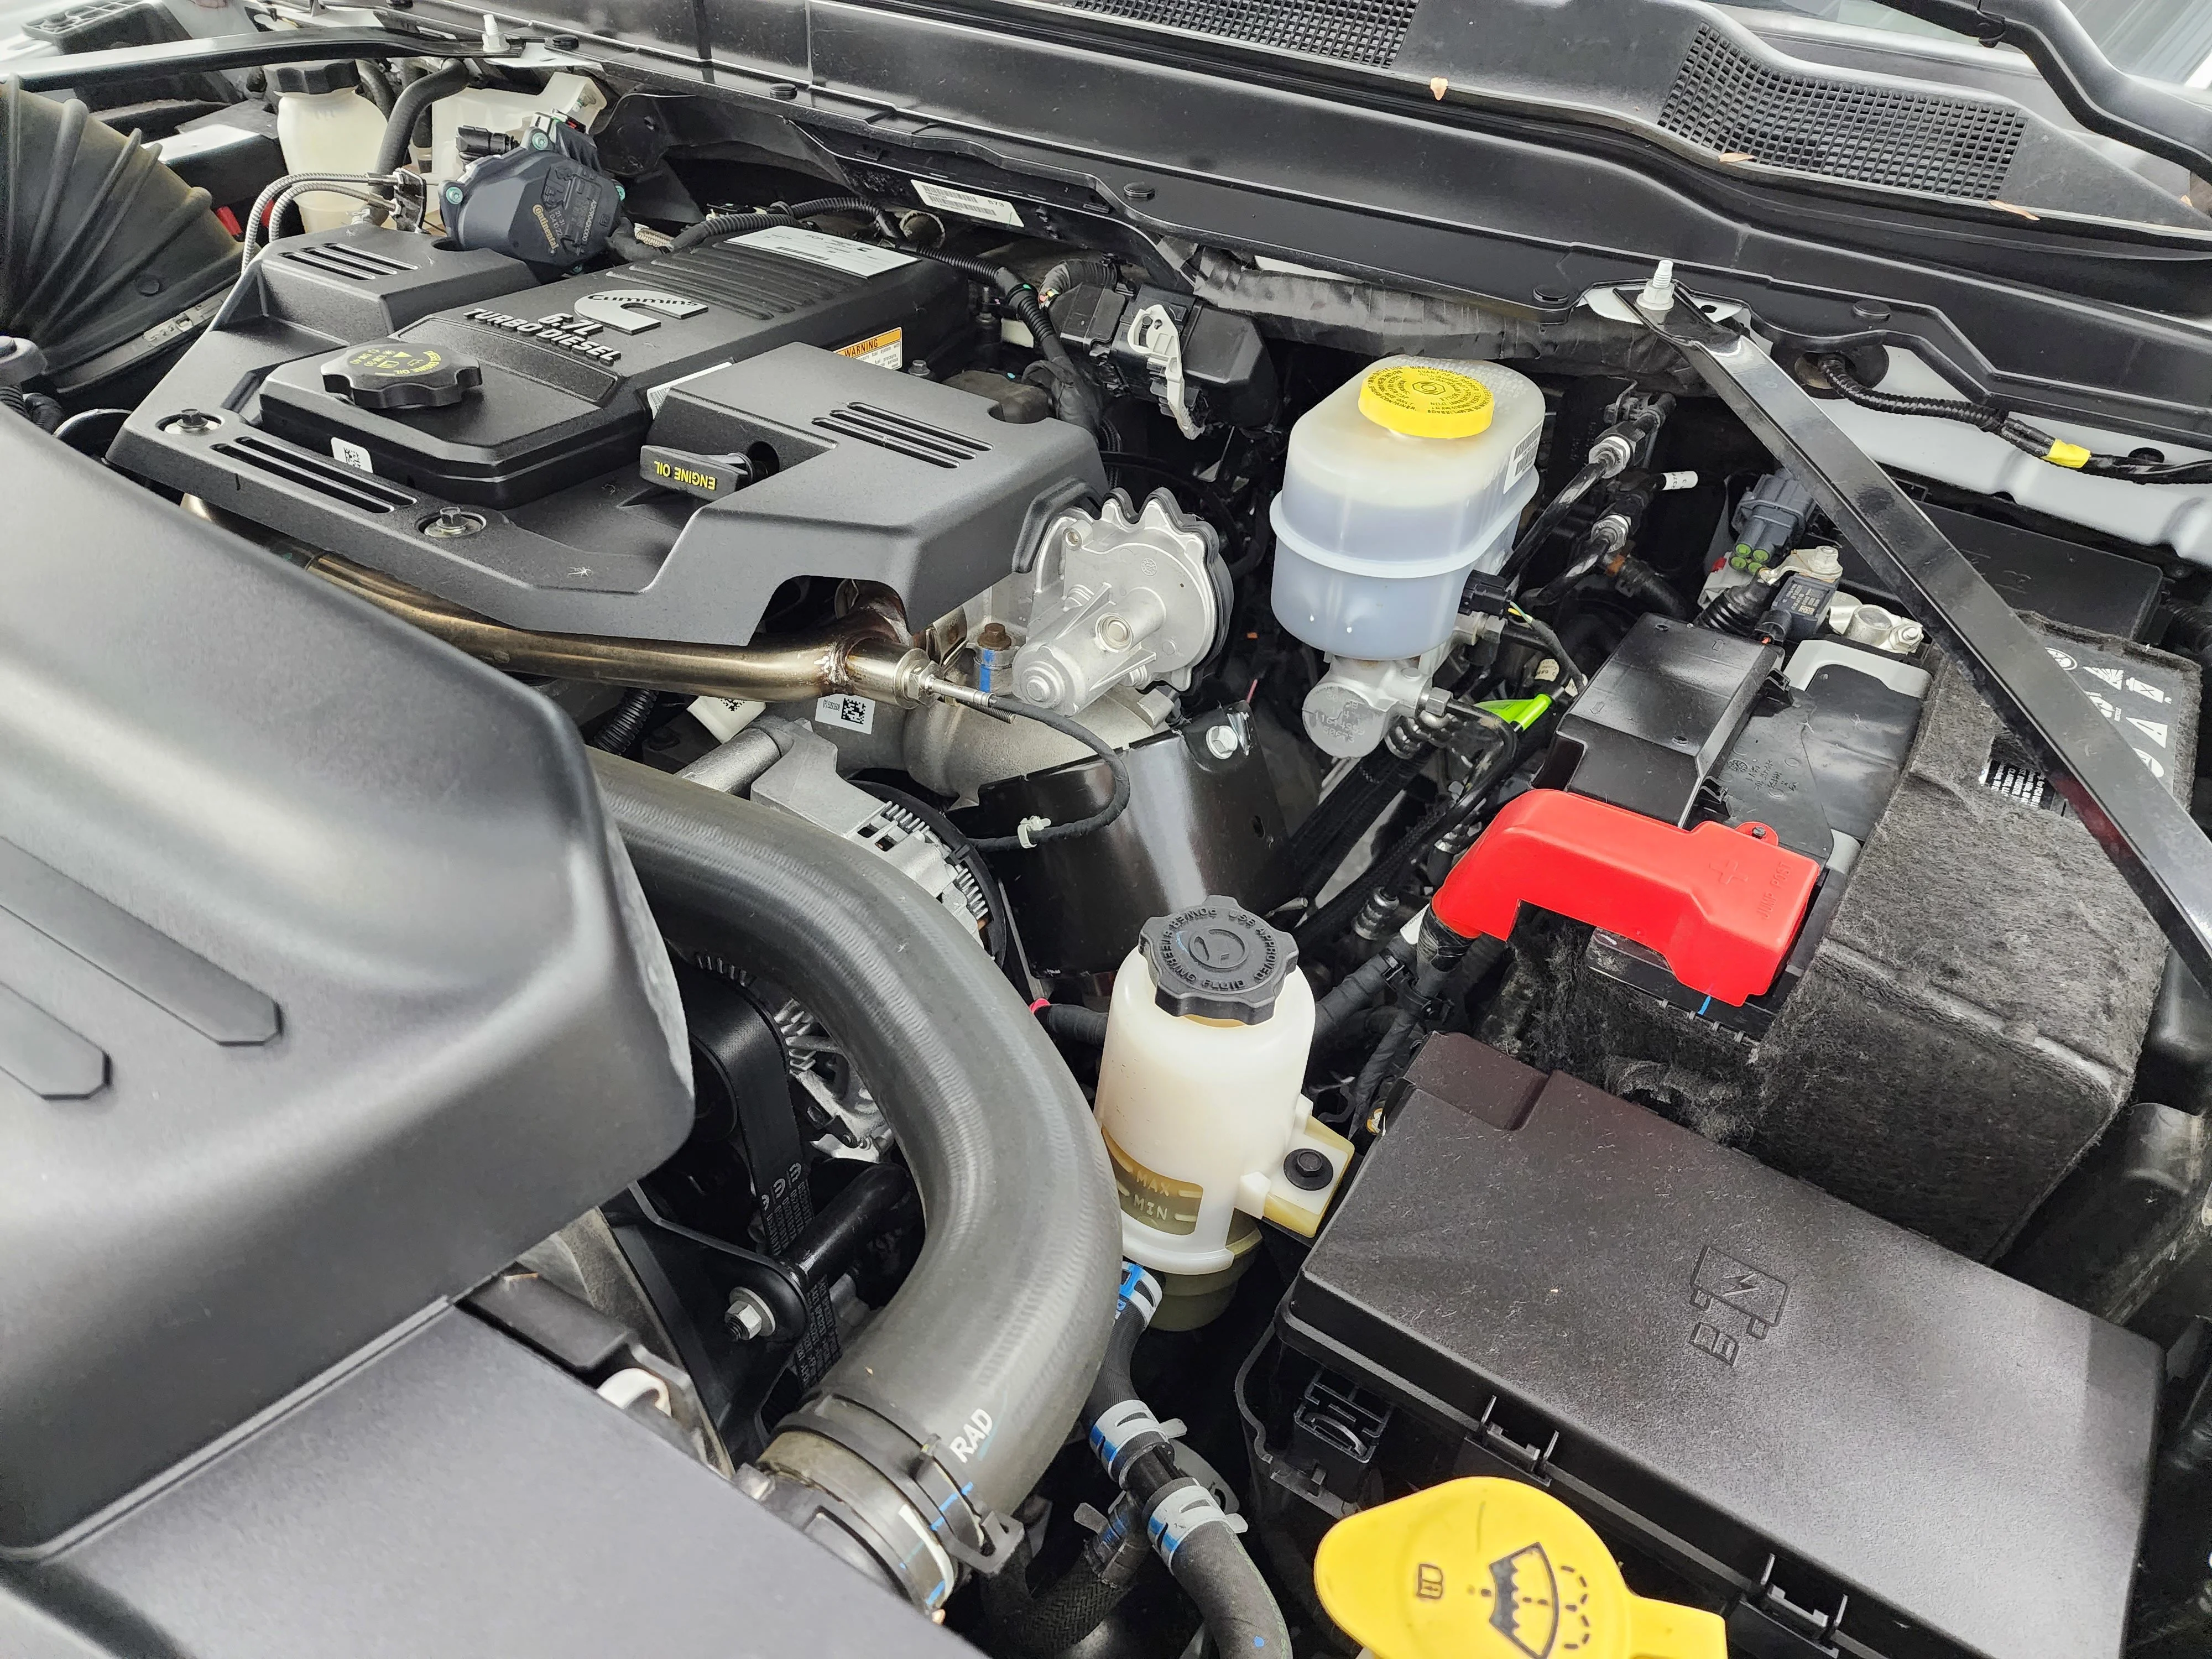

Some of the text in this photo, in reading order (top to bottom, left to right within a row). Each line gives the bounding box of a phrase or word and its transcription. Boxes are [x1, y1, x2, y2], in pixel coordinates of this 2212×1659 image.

[532, 204, 559, 249] Continental
[588, 295, 700, 306] Cummins
[463, 308, 621, 366] TURBO DIESEL
[538, 313, 604, 338] 6.7L
[844, 339, 878, 357] WARNING
[654, 460, 717, 491] ENGINE OIL
[1759, 861, 1792, 920] JUMP POST
[1161, 907, 1246, 991] POWER STEERING FLUID
[1228, 911, 1276, 981] USE APPROVED
[1136, 1173, 1170, 1196] MAX
[1133, 1194, 1168, 1220] MIN
[948, 1408, 994, 1463] RAD
